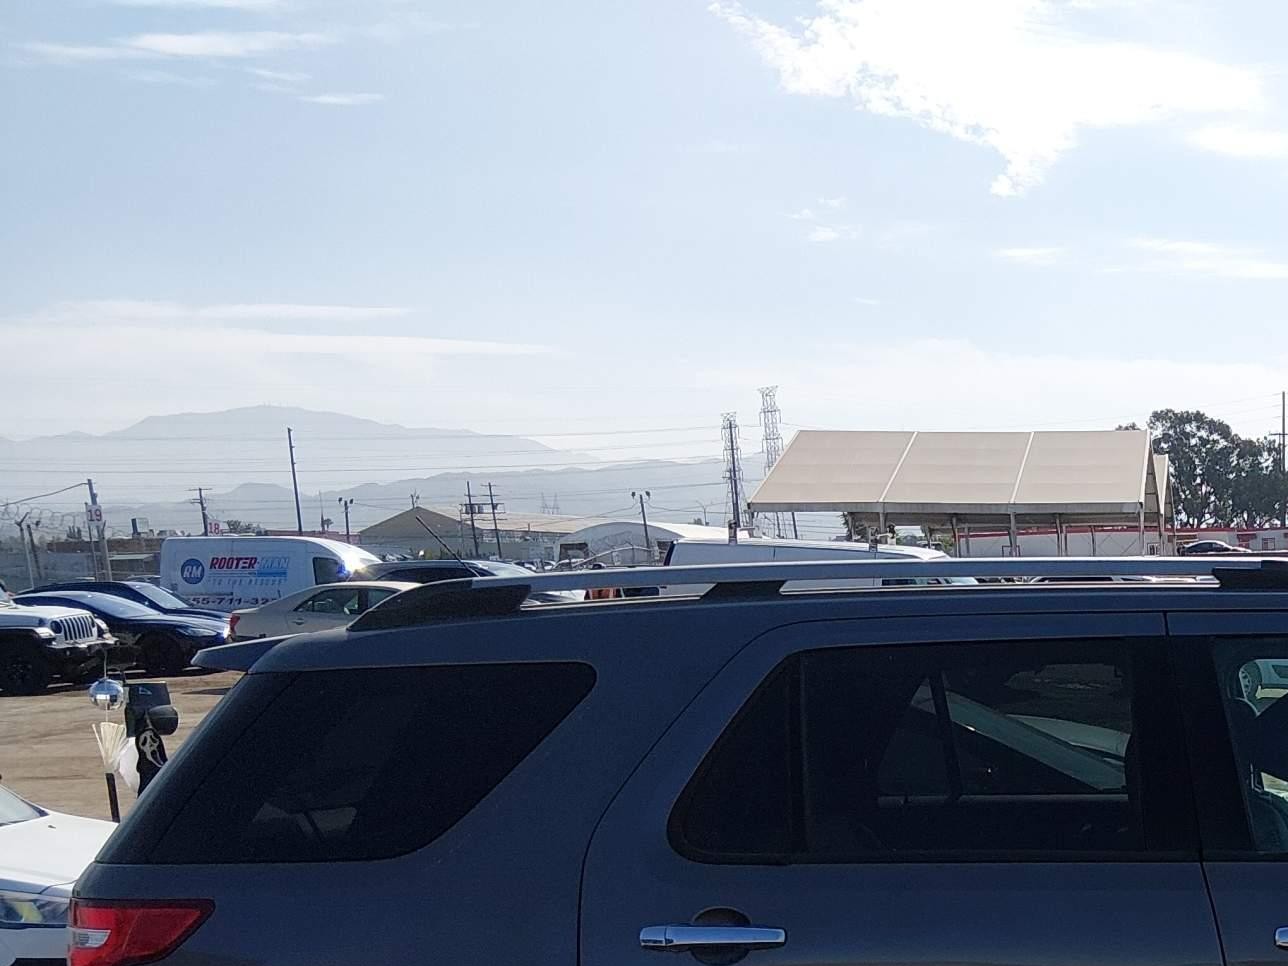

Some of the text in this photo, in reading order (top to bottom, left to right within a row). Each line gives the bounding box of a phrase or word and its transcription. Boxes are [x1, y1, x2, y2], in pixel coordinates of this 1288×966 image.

[87, 509, 102, 521] 19
[208, 522, 220, 535] 18
[183, 566, 202, 579] RM
